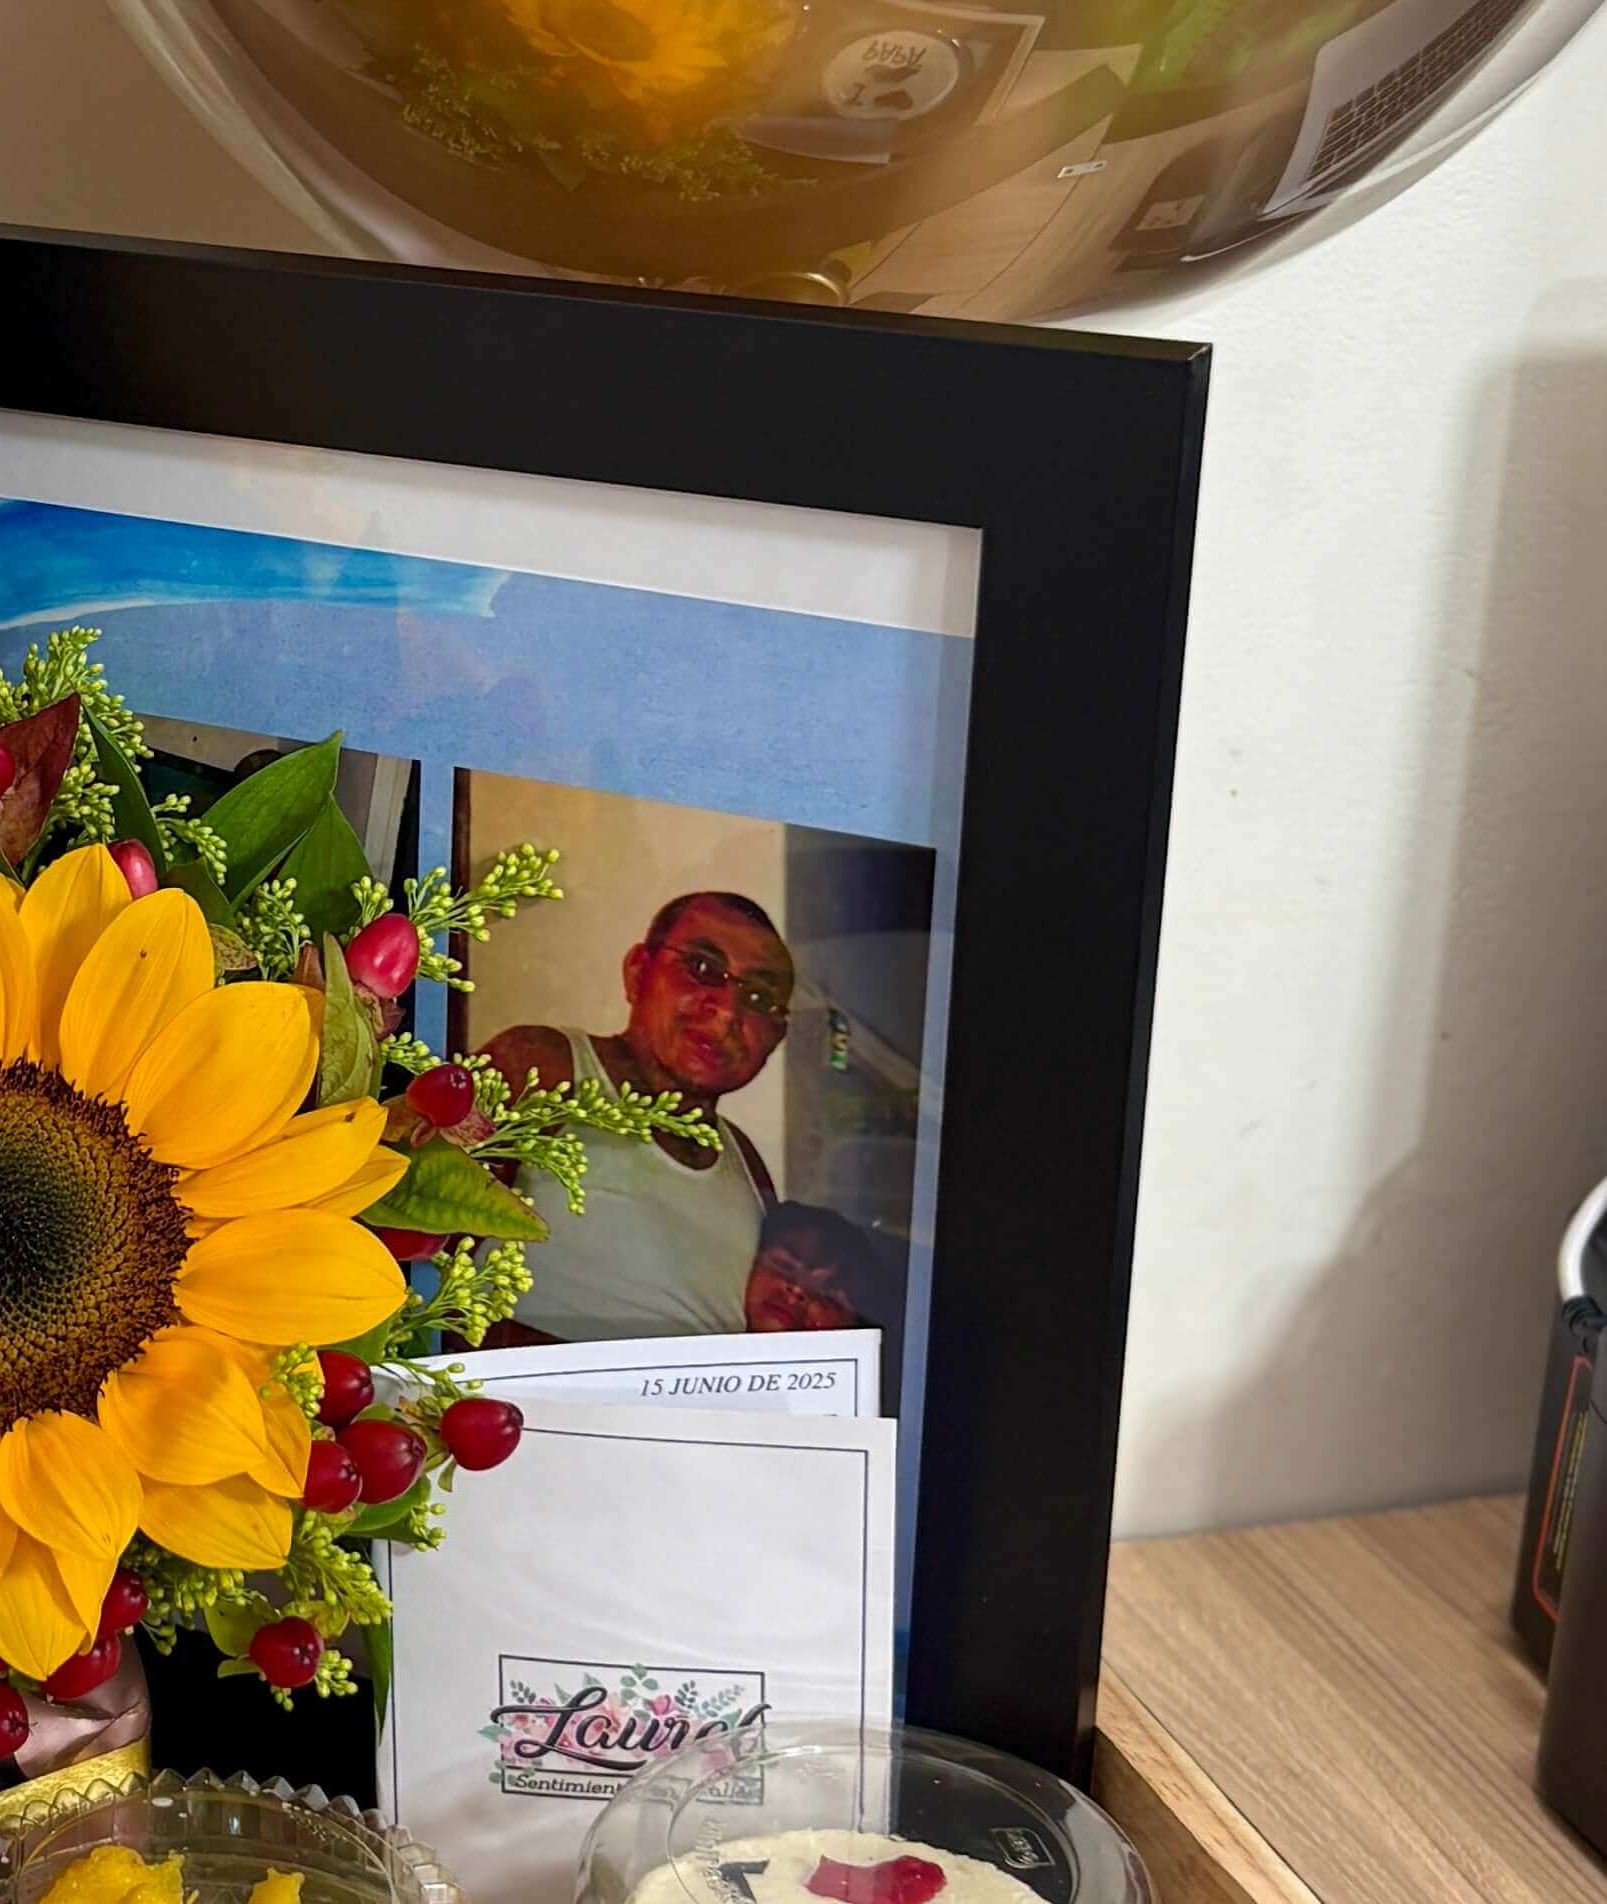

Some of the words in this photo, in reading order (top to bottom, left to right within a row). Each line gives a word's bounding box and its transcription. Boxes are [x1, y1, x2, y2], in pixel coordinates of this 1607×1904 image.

[640, 1378, 663, 1396] 15
[668, 1375, 742, 1395] JUNIO
[747, 1374, 782, 1392] DE
[787, 1372, 837, 1390] 2025
